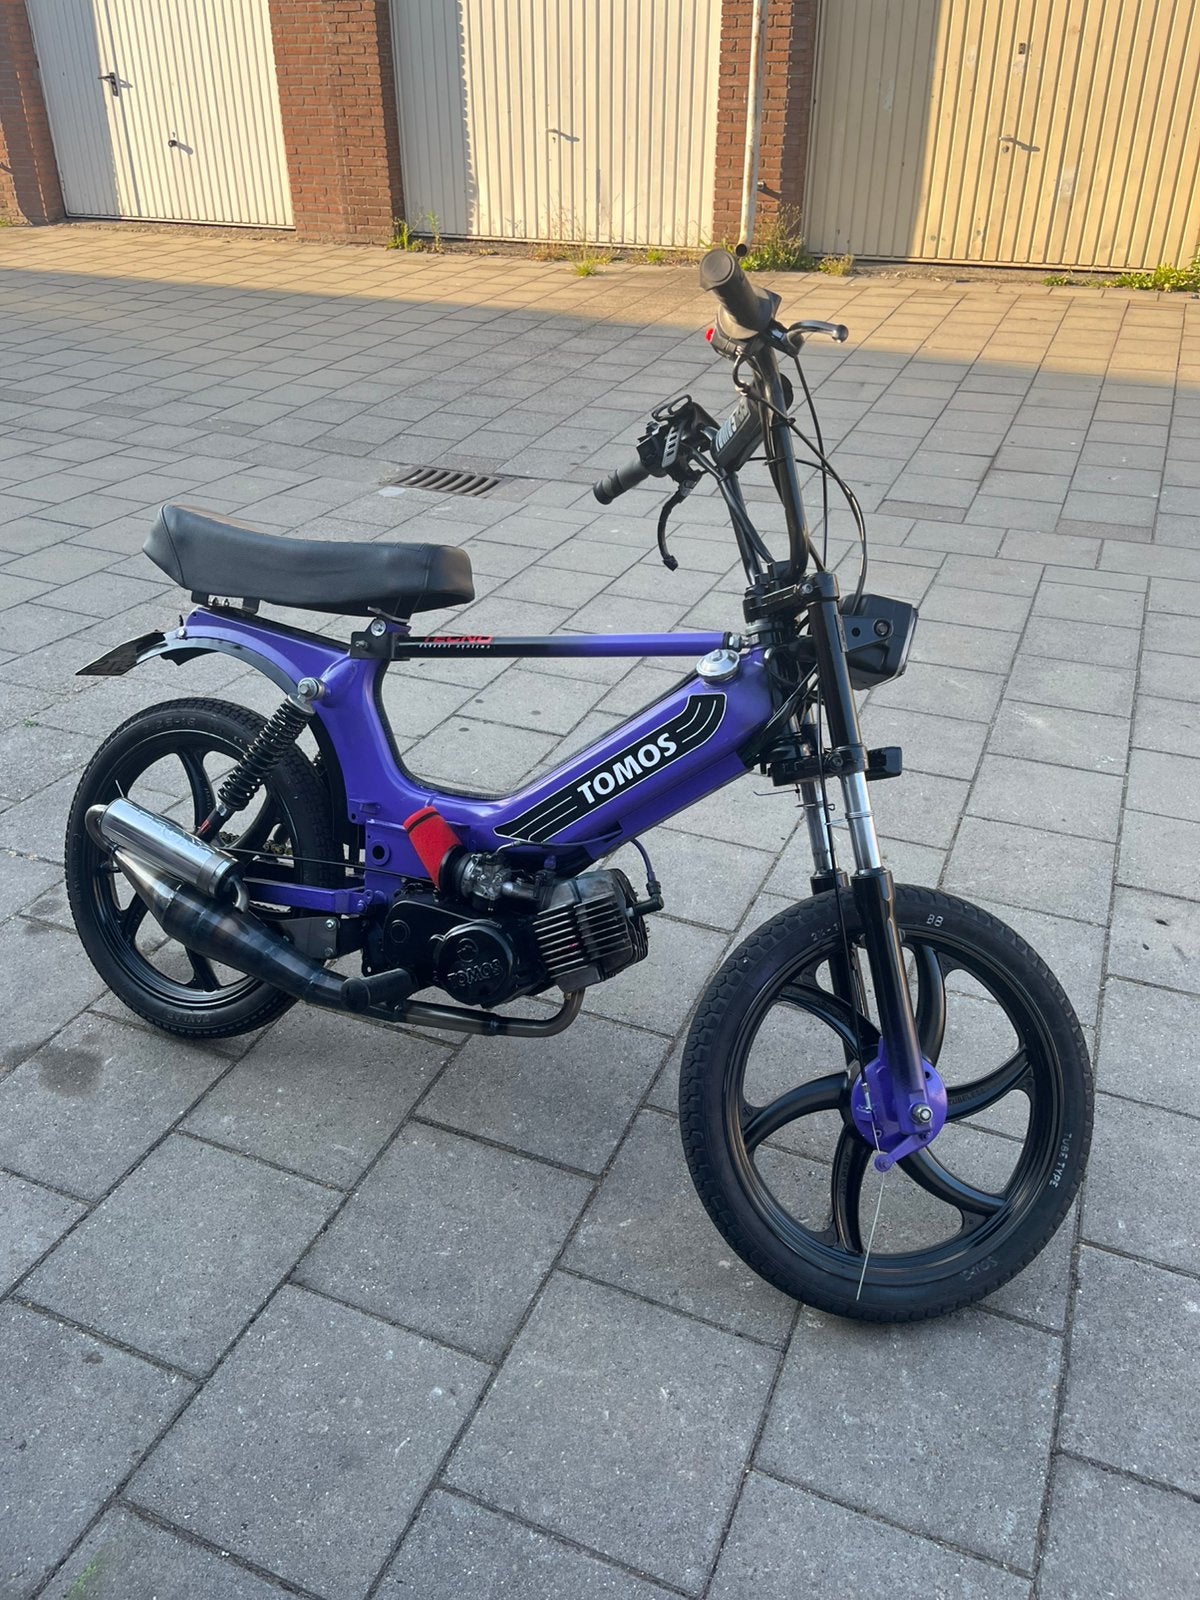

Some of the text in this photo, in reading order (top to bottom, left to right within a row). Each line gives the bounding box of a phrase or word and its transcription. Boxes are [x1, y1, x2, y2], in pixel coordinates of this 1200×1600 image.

[577, 733, 677, 804] TOMOS
[447, 958, 501, 987] TOMOS
[1049, 1133, 1073, 1188] TUBE TYPE
